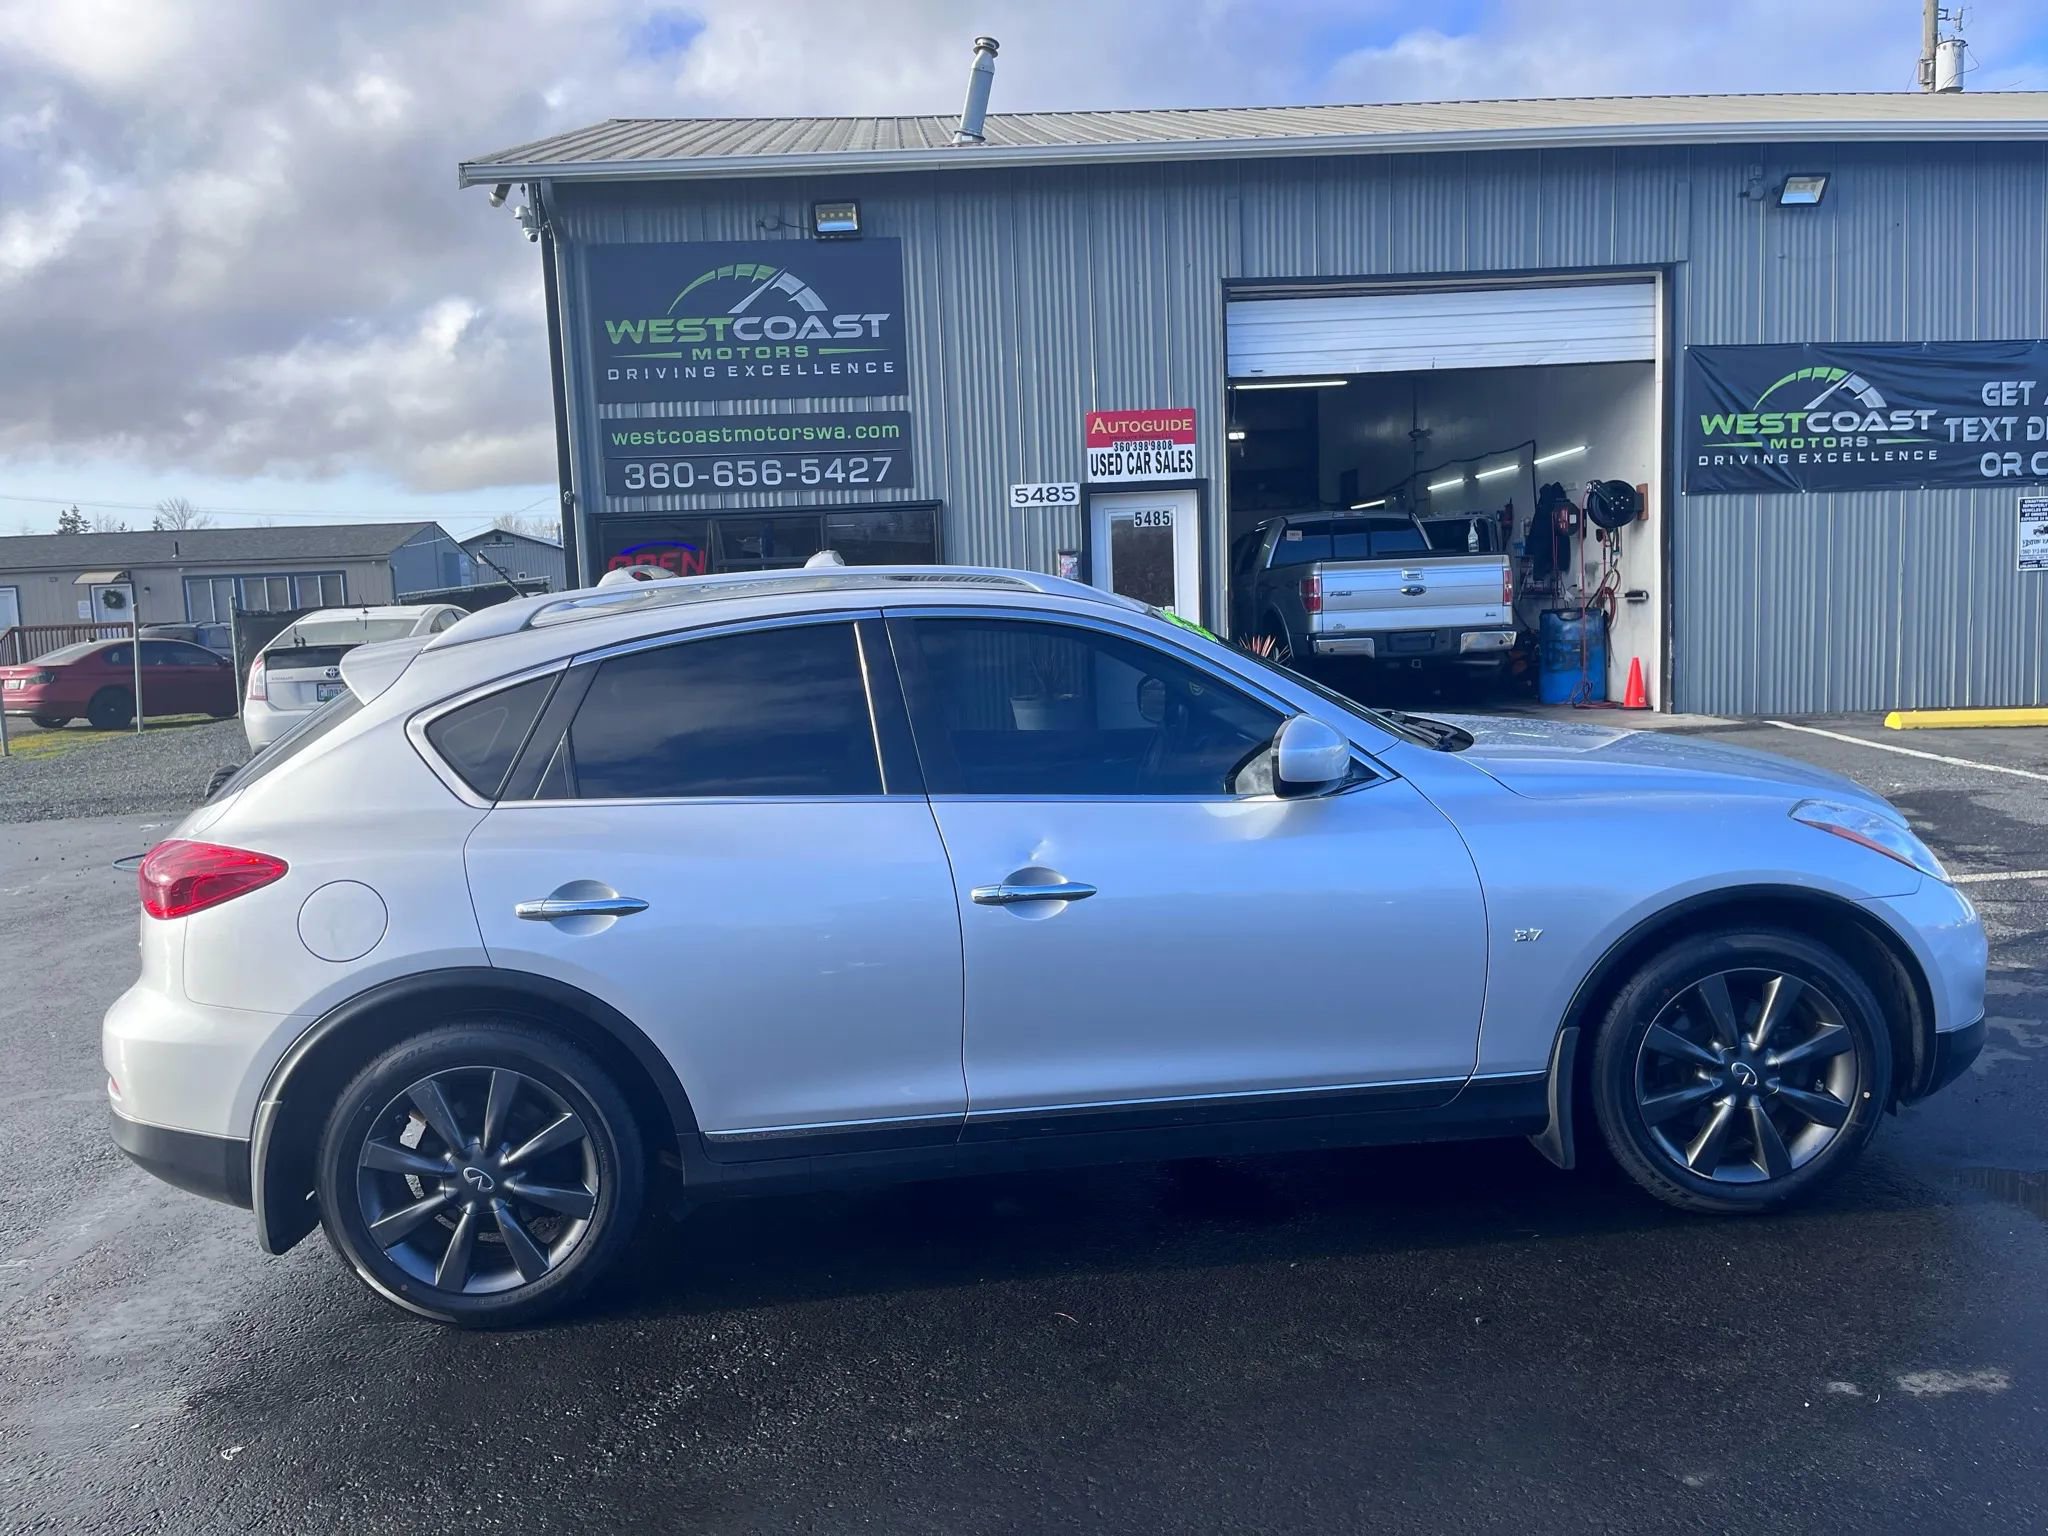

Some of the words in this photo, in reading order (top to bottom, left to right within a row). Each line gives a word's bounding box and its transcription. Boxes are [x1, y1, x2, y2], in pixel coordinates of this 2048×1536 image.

[605, 313, 891, 345] WESTCOAST
[692, 346, 809, 361] MOTORS
[608, 366, 716, 381] DRIVING
[728, 361, 894, 378] EXCELLENCE
[1982, 381, 2036, 406] GET
[1700, 409, 1938, 435] WESTCOAST
[1944, 416, 2019, 442] TEXT
[612, 423, 900, 446] westcoastmotorswa.com
[1770, 436, 1869, 449] MOTORS
[1090, 452, 1123, 476] USED
[1127, 451, 1152, 475] CAR
[1155, 449, 1193, 473] SALES
[1698, 454, 1789, 467] DRIVING
[1798, 450, 1938, 463] EXCELLENCE
[1980, 452, 2022, 477] OR
[624, 456, 893, 489] 360-656-5427
[1014, 486, 1076, 504] 5485
[1135, 510, 1171, 526] 5485
